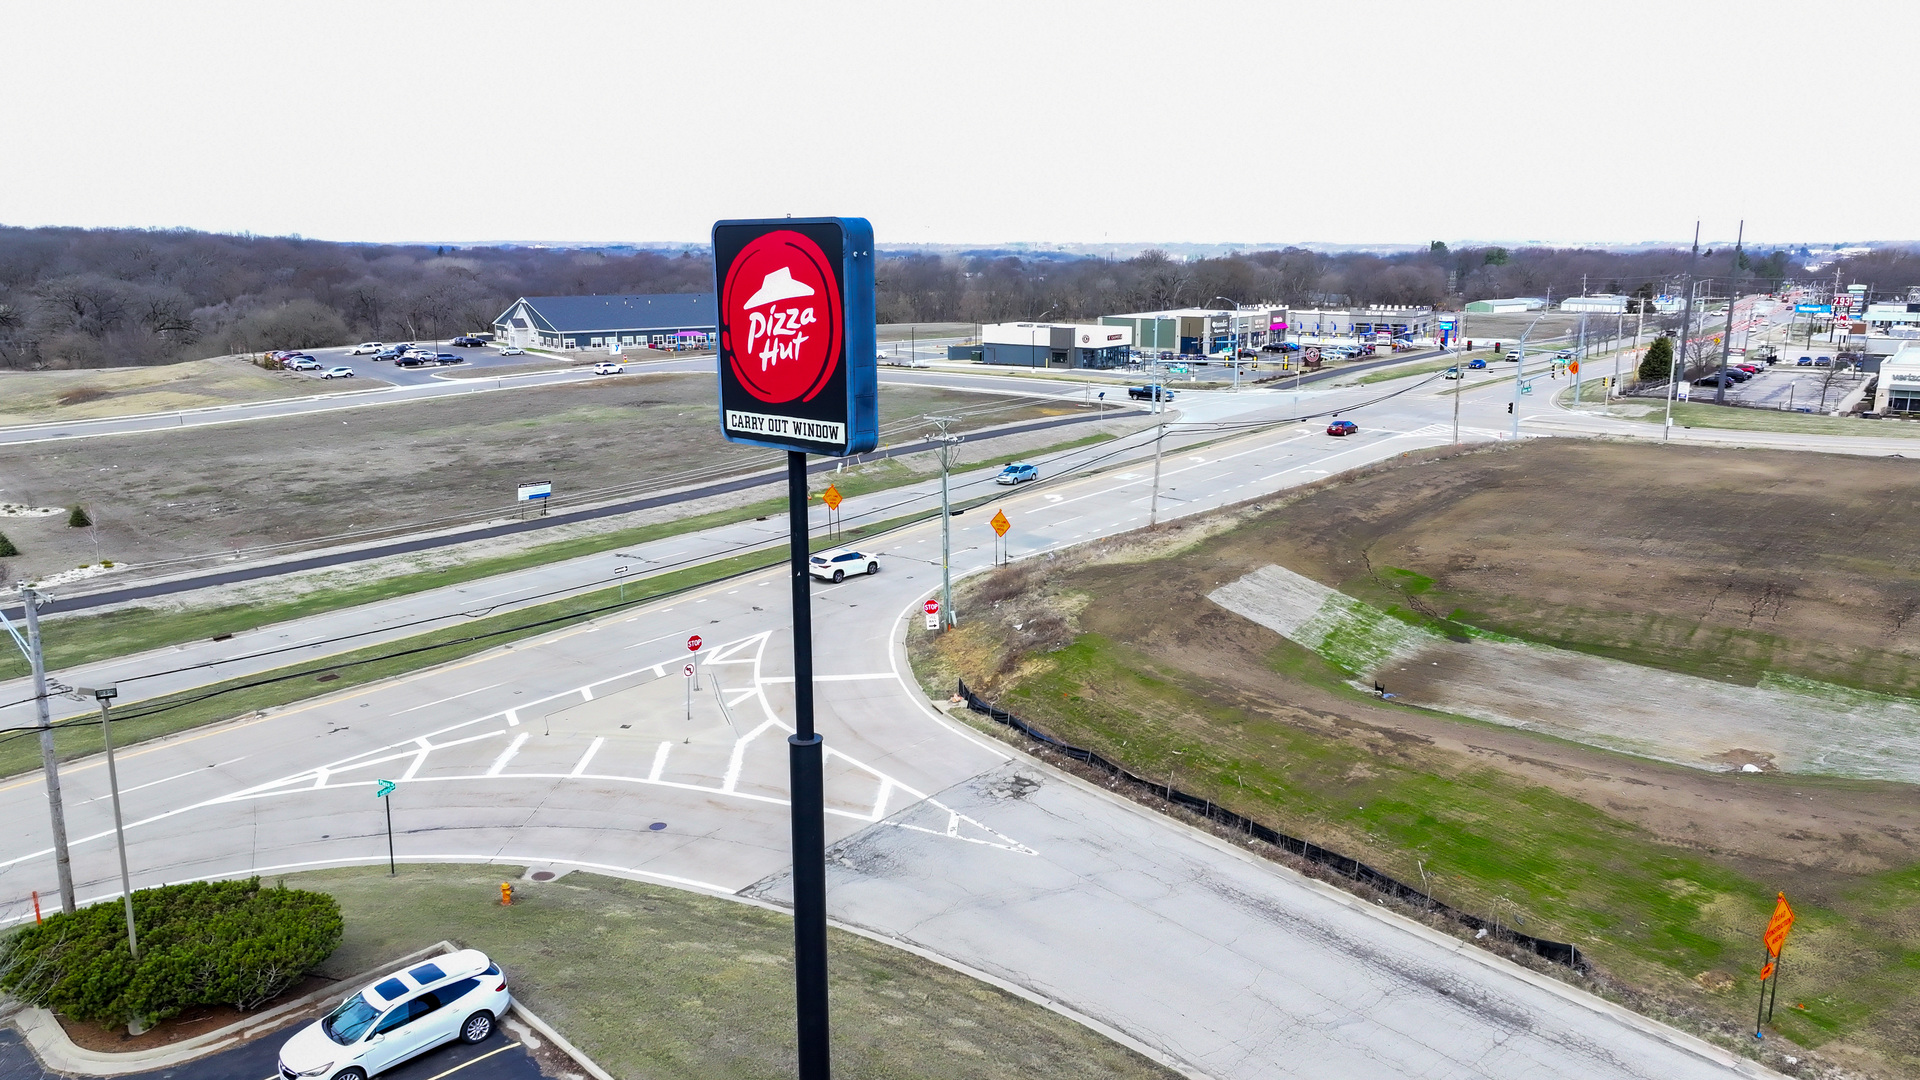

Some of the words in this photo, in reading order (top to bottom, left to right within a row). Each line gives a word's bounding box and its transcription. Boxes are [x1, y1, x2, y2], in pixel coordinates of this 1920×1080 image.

[759, 331, 810, 372] Hut
[731, 414, 765, 430] CARRY
[768, 418, 789, 434] OUT
[792, 421, 840, 440] WINDOW
[924, 603, 938, 611] STOP
[688, 638, 702, 648] STOP
